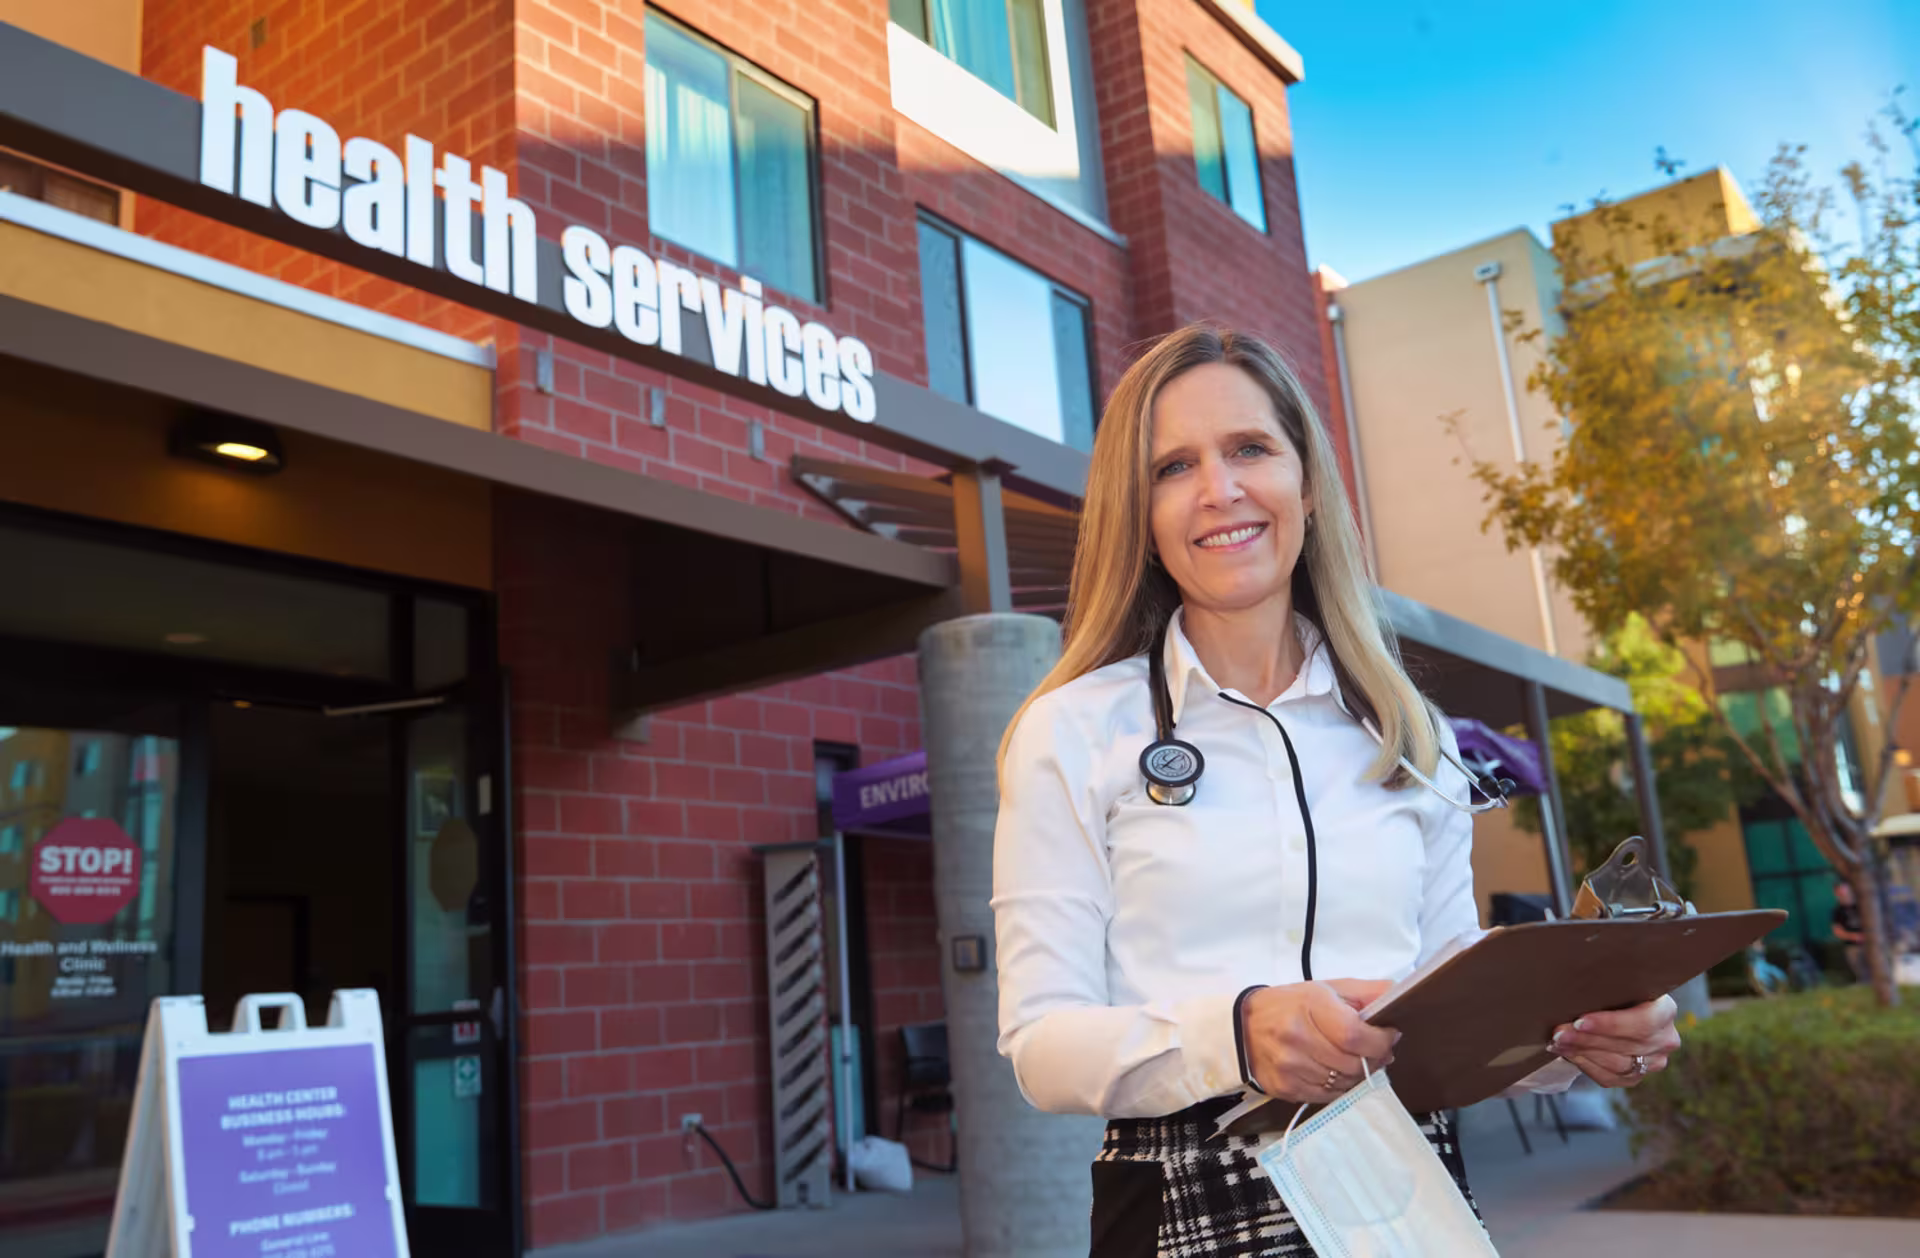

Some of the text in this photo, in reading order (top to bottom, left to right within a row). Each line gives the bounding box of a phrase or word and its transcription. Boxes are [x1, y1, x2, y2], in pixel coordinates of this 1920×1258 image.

[200, 46, 876, 423] health services
[39, 846, 133, 874] STOP!
